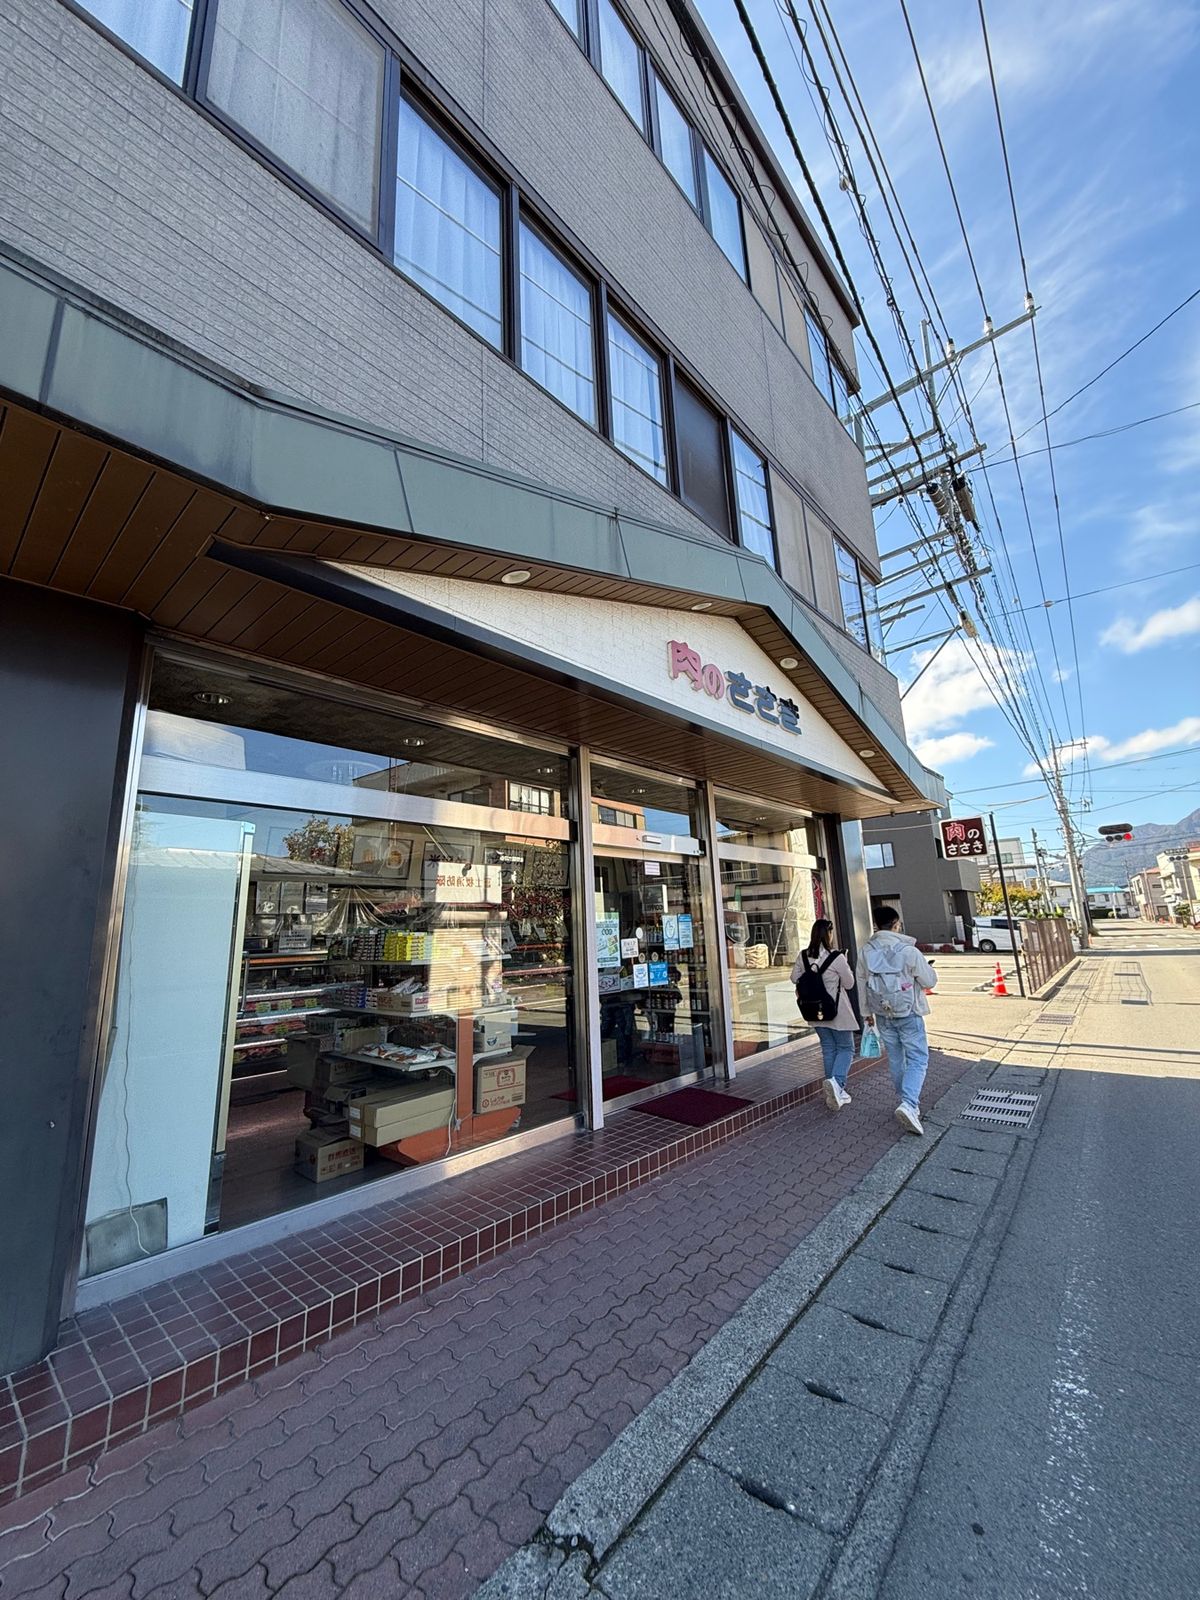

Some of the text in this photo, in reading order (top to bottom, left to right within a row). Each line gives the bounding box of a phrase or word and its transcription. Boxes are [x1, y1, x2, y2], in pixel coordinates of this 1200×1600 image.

[666, 640, 802, 735] 肉のささき
[945, 823, 980, 841] 肉の
[947, 841, 983, 855] ささき
